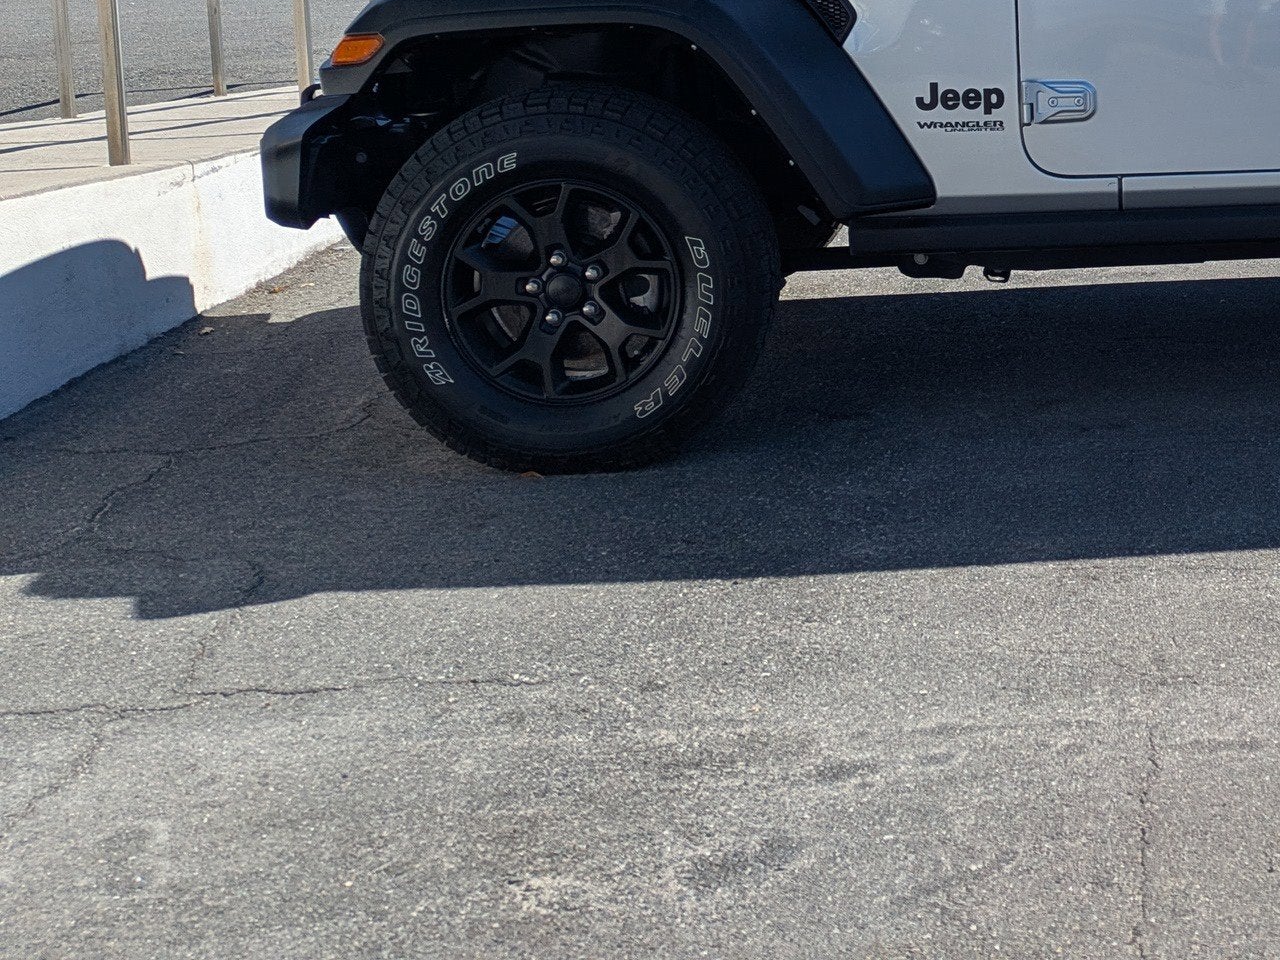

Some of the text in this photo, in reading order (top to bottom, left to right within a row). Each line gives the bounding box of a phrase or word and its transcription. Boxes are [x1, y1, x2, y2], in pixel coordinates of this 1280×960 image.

[915, 82, 1005, 115] Jeep
[917, 120, 1005, 130] WRANGLER
[399, 151, 518, 387] BRIDGESTONE
[633, 235, 716, 420] DUELER
